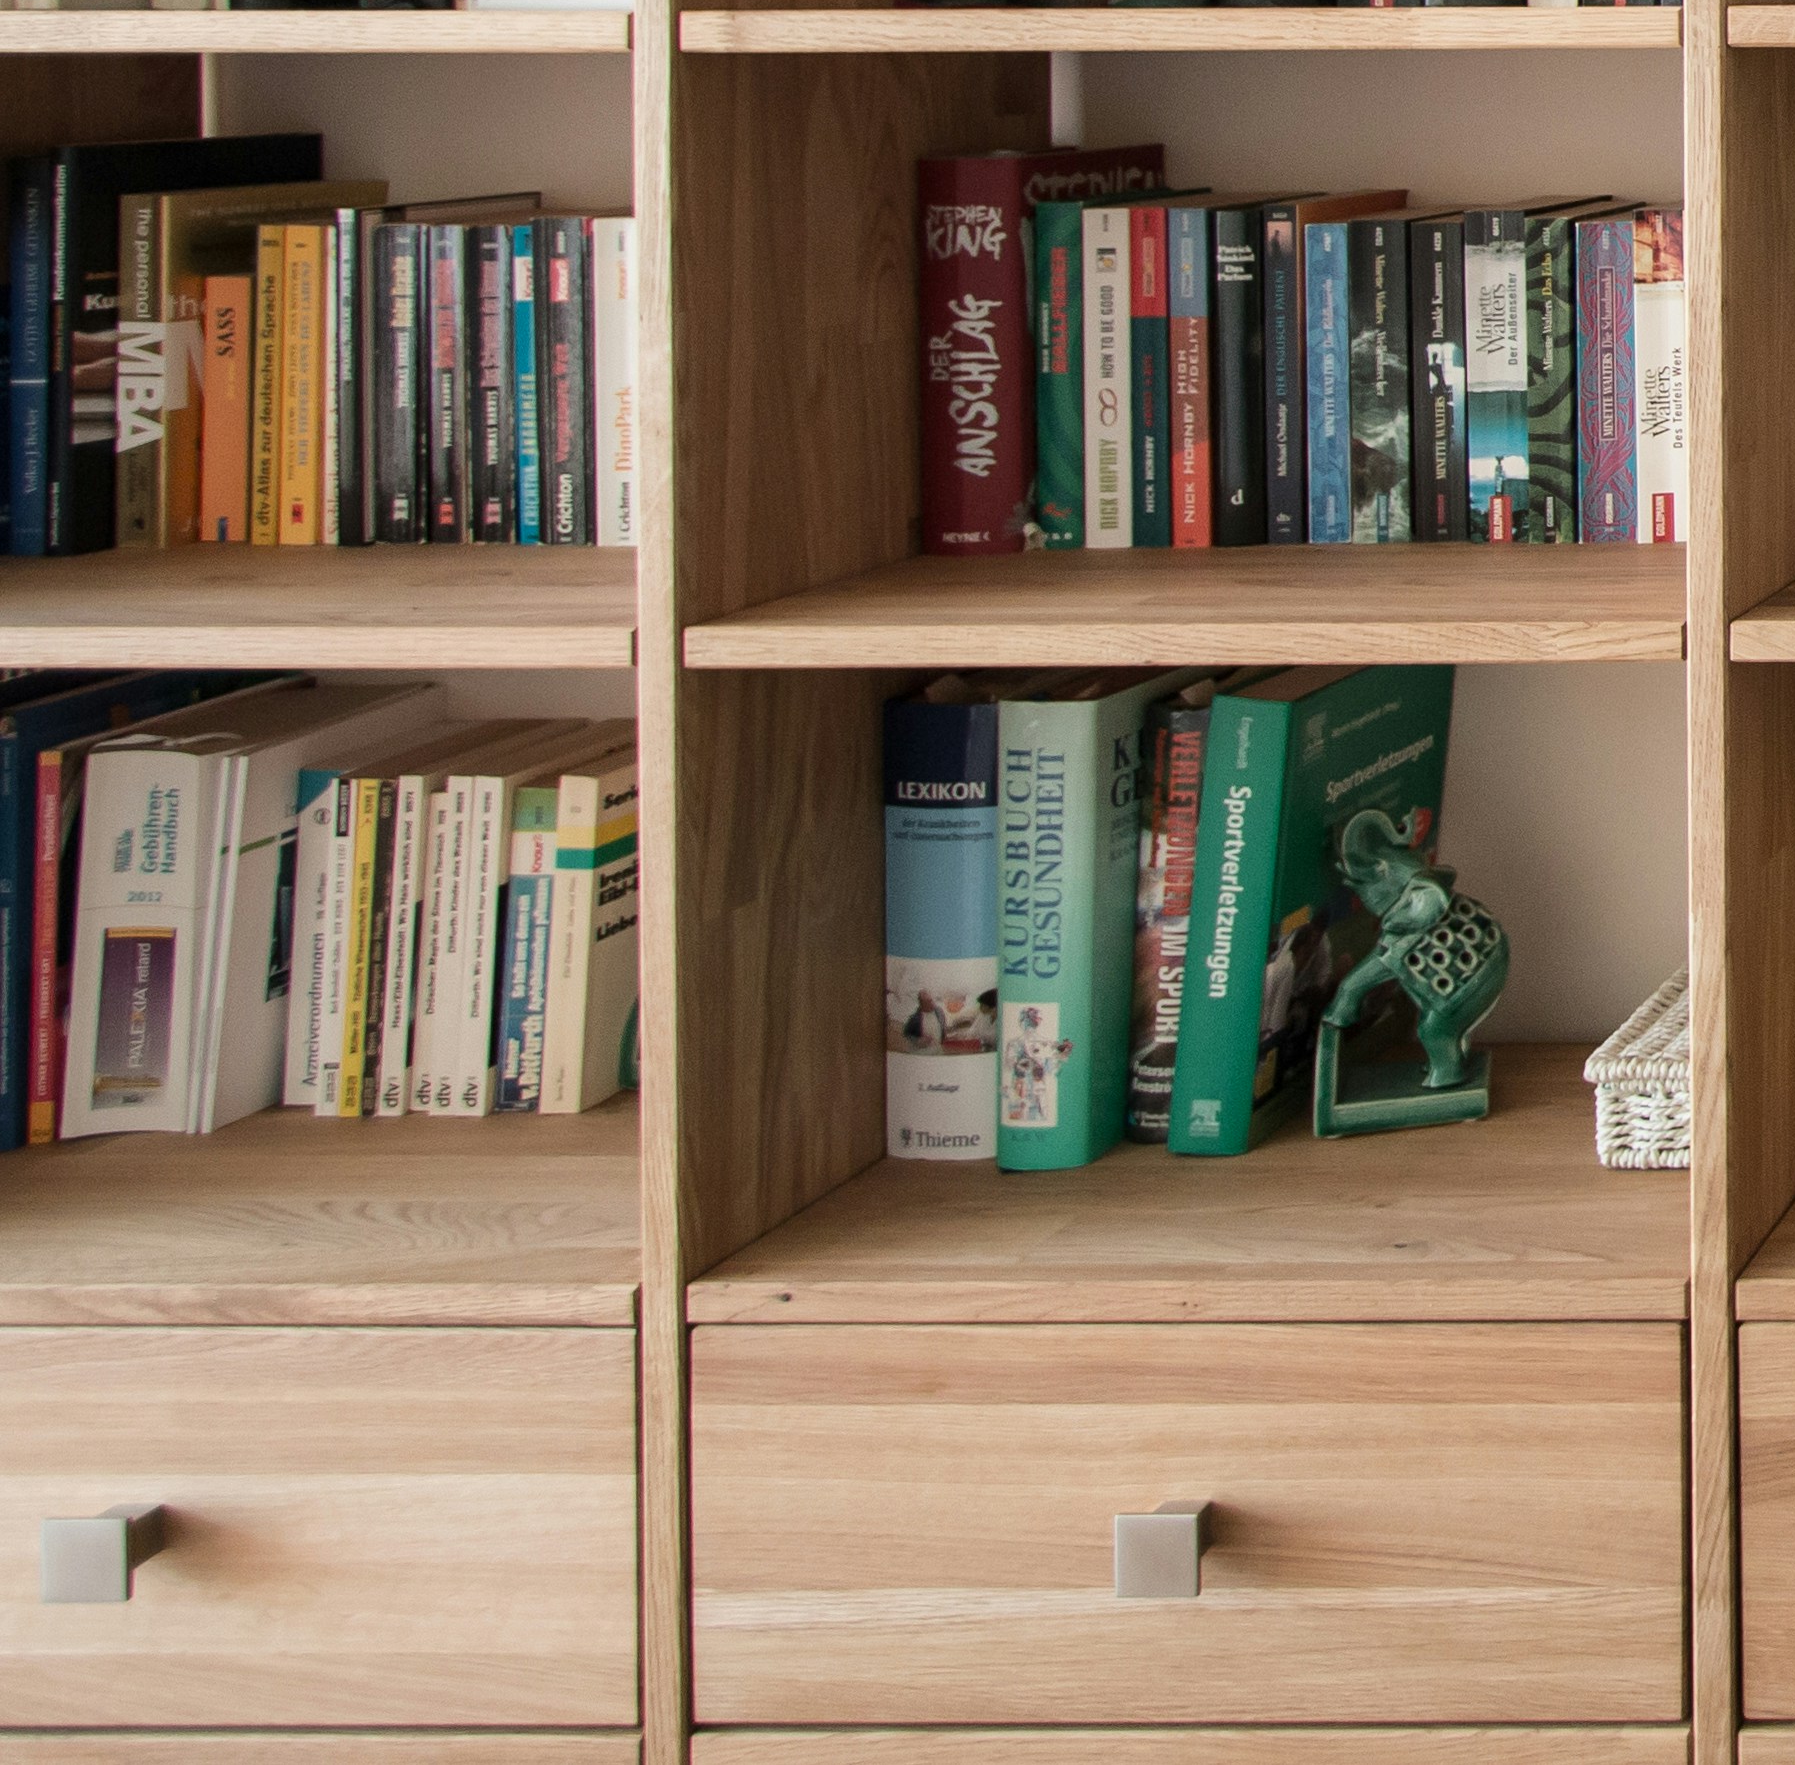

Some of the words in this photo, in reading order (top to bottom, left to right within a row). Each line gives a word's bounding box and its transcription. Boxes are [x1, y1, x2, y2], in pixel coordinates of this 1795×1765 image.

[216, 307, 236, 357] SASS
[930, 331, 951, 381] DER
[1475, 286, 1494, 352] Minette
[1488, 283, 1507, 354] Walters
[950, 294, 1002, 477] ANSCHLAG
[612, 386, 635, 471] DinoPark
[556, 473, 574, 533] Crichton
[898, 782, 987, 800] LEXIKON
[161, 787, 180, 874] Handbuch
[1004, 748, 1032, 977] KURSBUCH
[1032, 746, 1065, 979] GESUNDHEIT
[1207, 784, 1251, 998] Sportverletzungen
